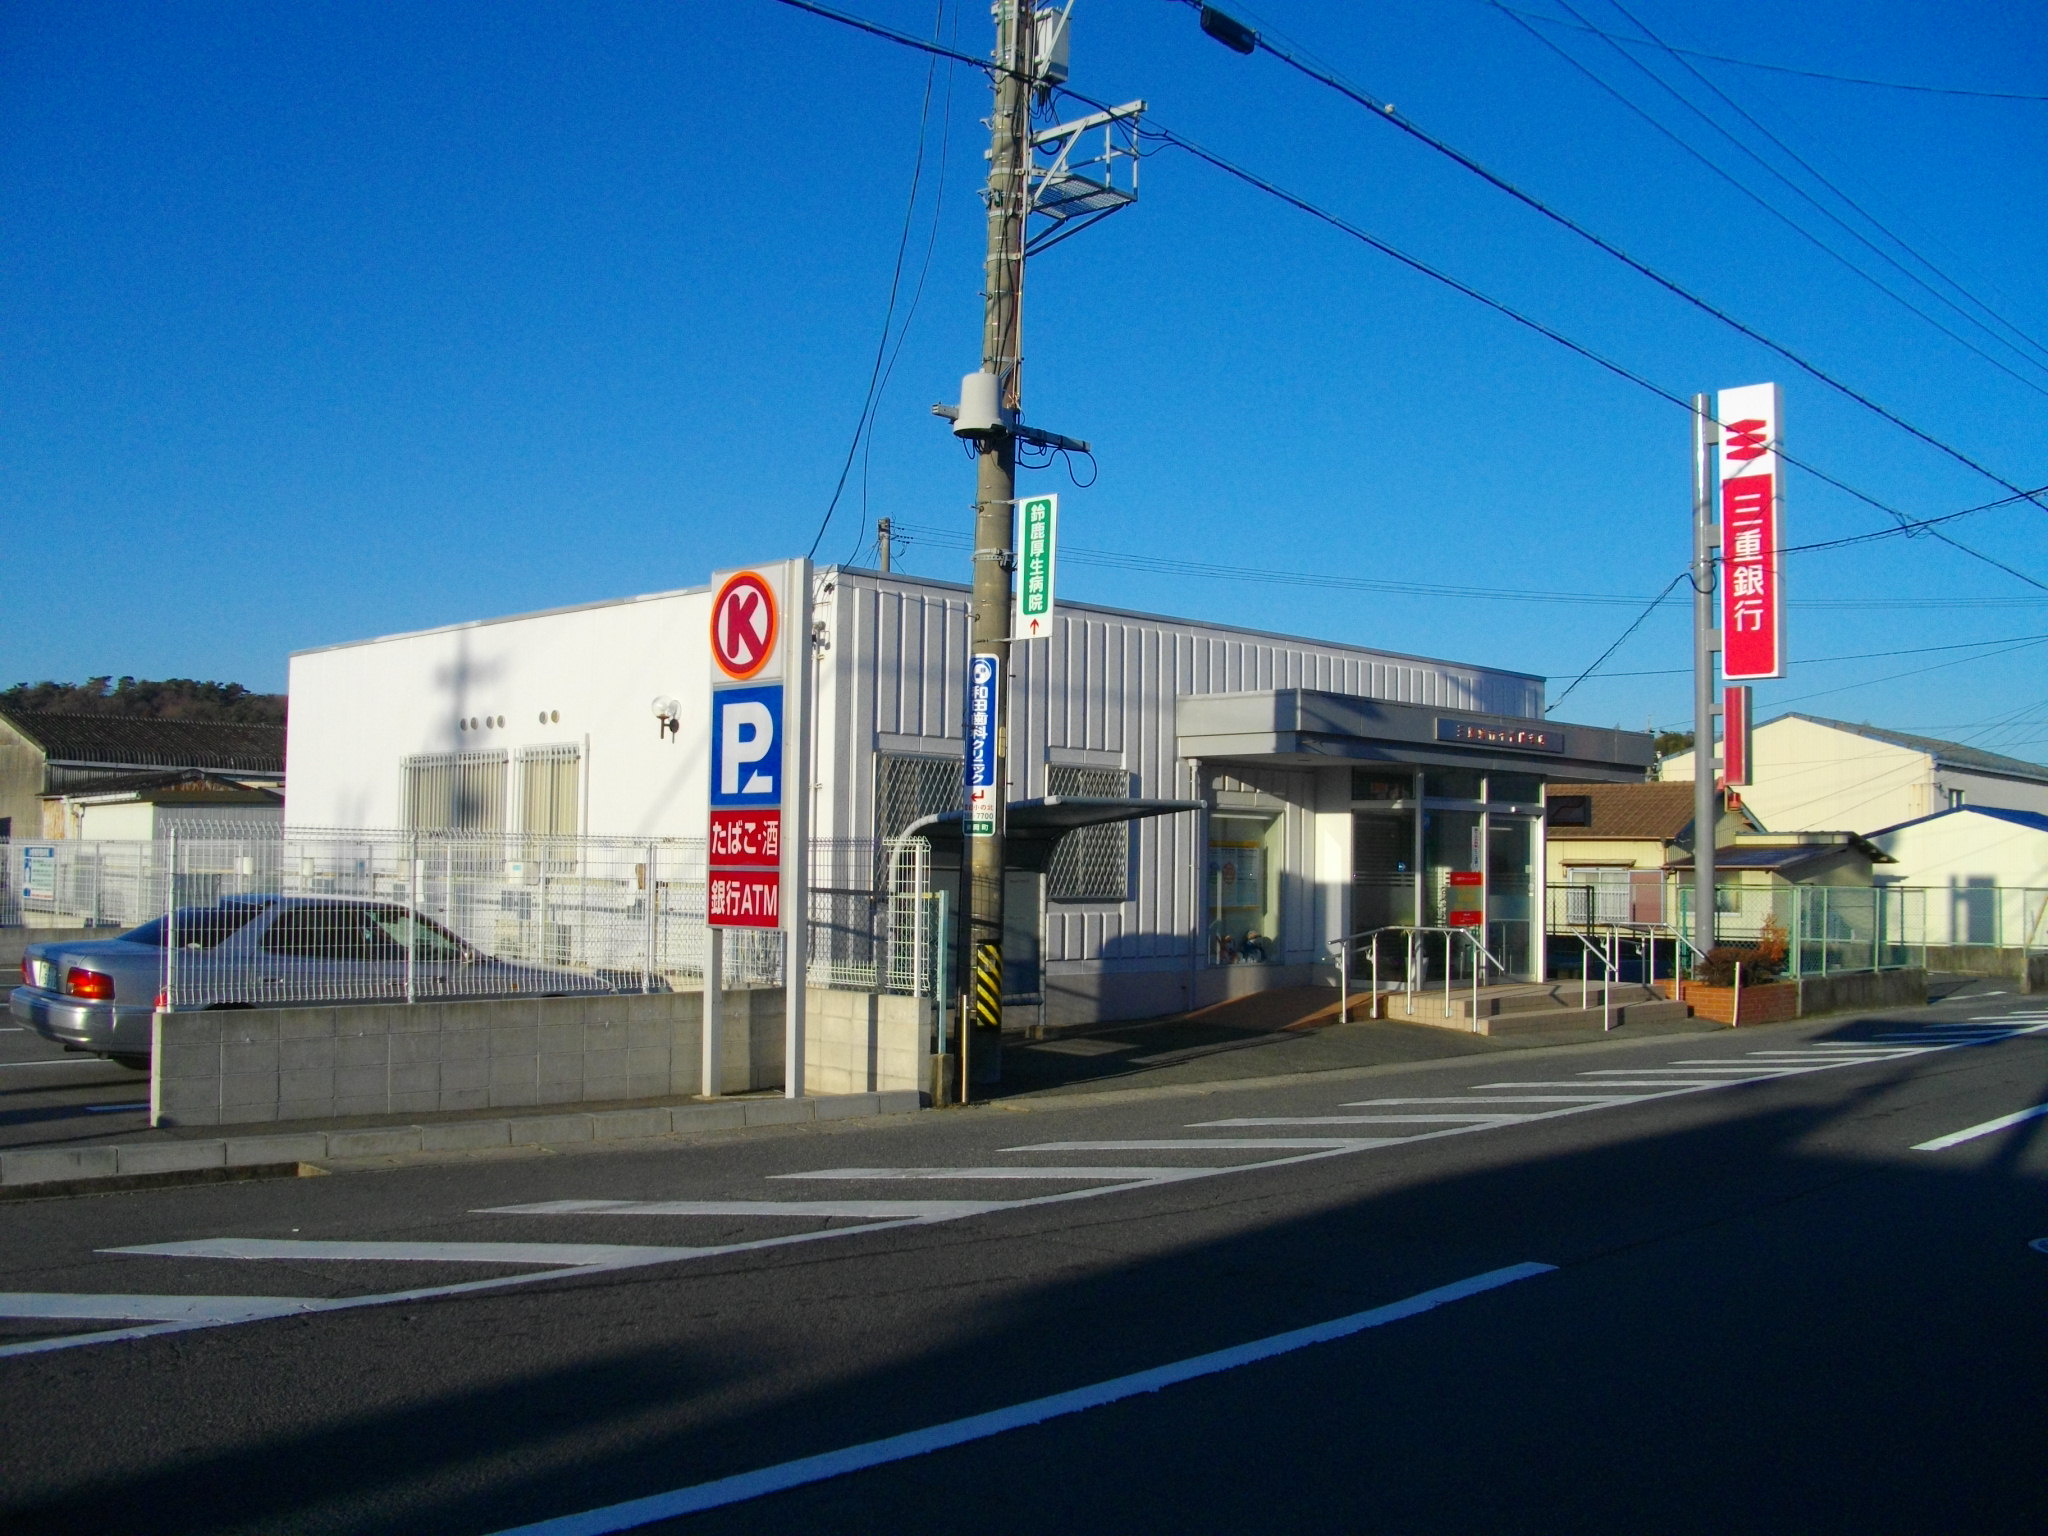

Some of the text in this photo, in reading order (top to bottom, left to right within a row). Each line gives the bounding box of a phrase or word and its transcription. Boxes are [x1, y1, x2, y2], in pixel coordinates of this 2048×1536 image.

[1029, 504, 1046, 612] 鈴鹿厚生病院
[1732, 493, 1764, 632] 三重銀行
[726, 591, 766, 662] K
[721, 701, 773, 795] P
[970, 686, 989, 784] 和田歯科クリニック
[711, 820, 779, 857] たばこ・酒
[710, 880, 778, 917] 銀行ATM
